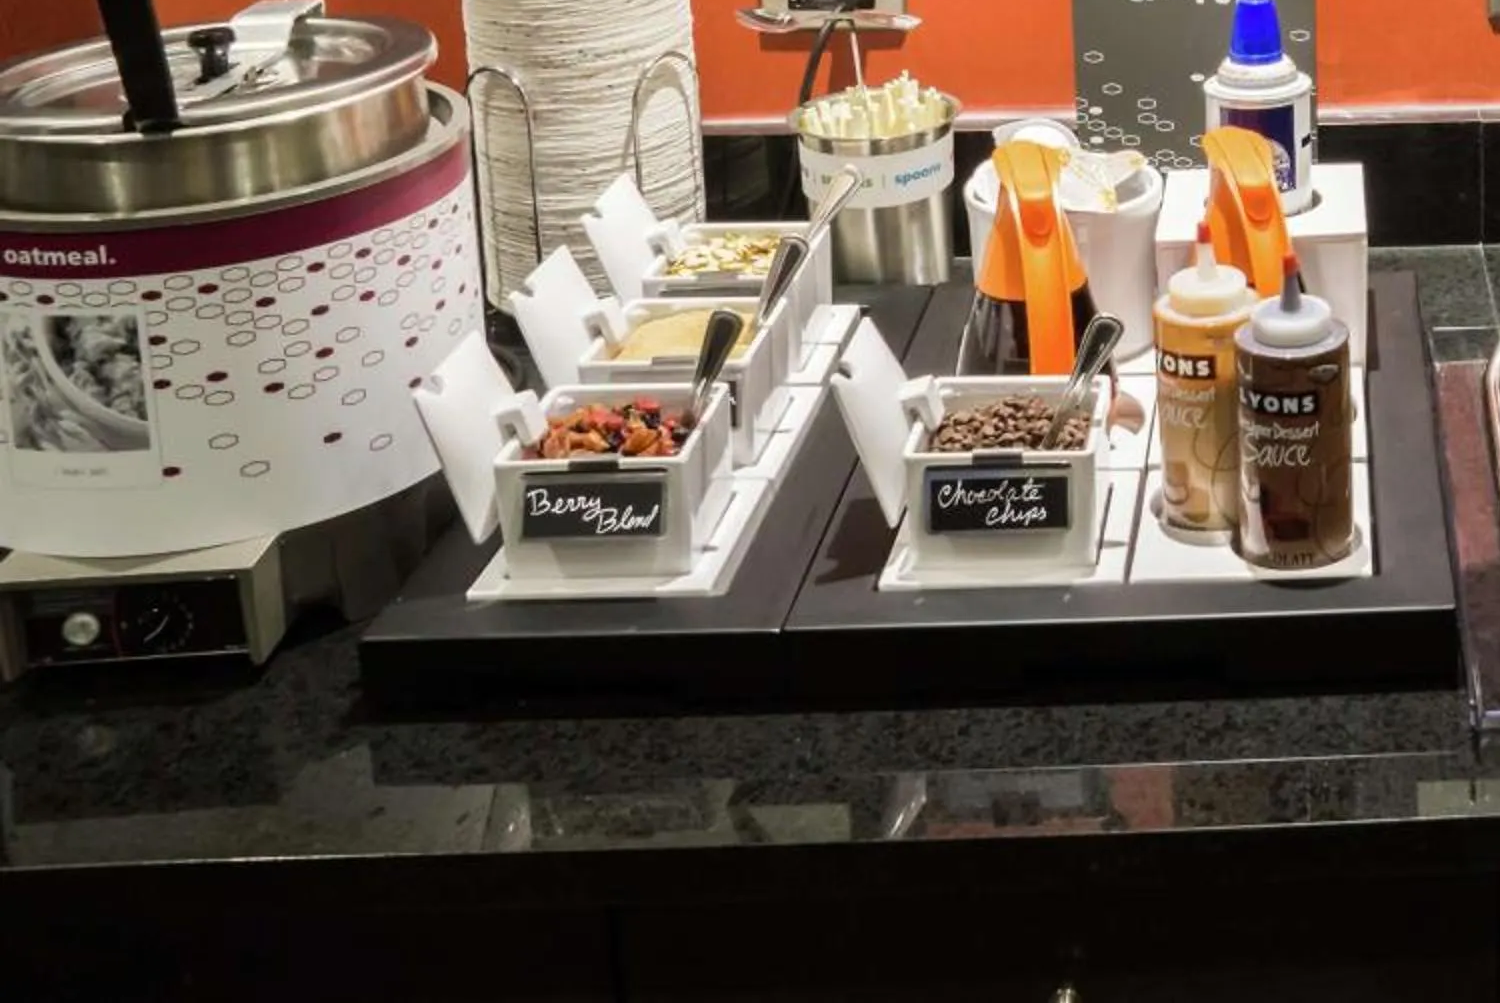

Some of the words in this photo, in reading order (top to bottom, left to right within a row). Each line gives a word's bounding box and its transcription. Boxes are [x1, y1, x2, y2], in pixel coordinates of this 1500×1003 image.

[3, 244, 118, 266] oatmeal.
[1239, 386, 1316, 414] LYONS
[1160, 404, 1208, 429] auce
[527, 488, 602, 522] Berry
